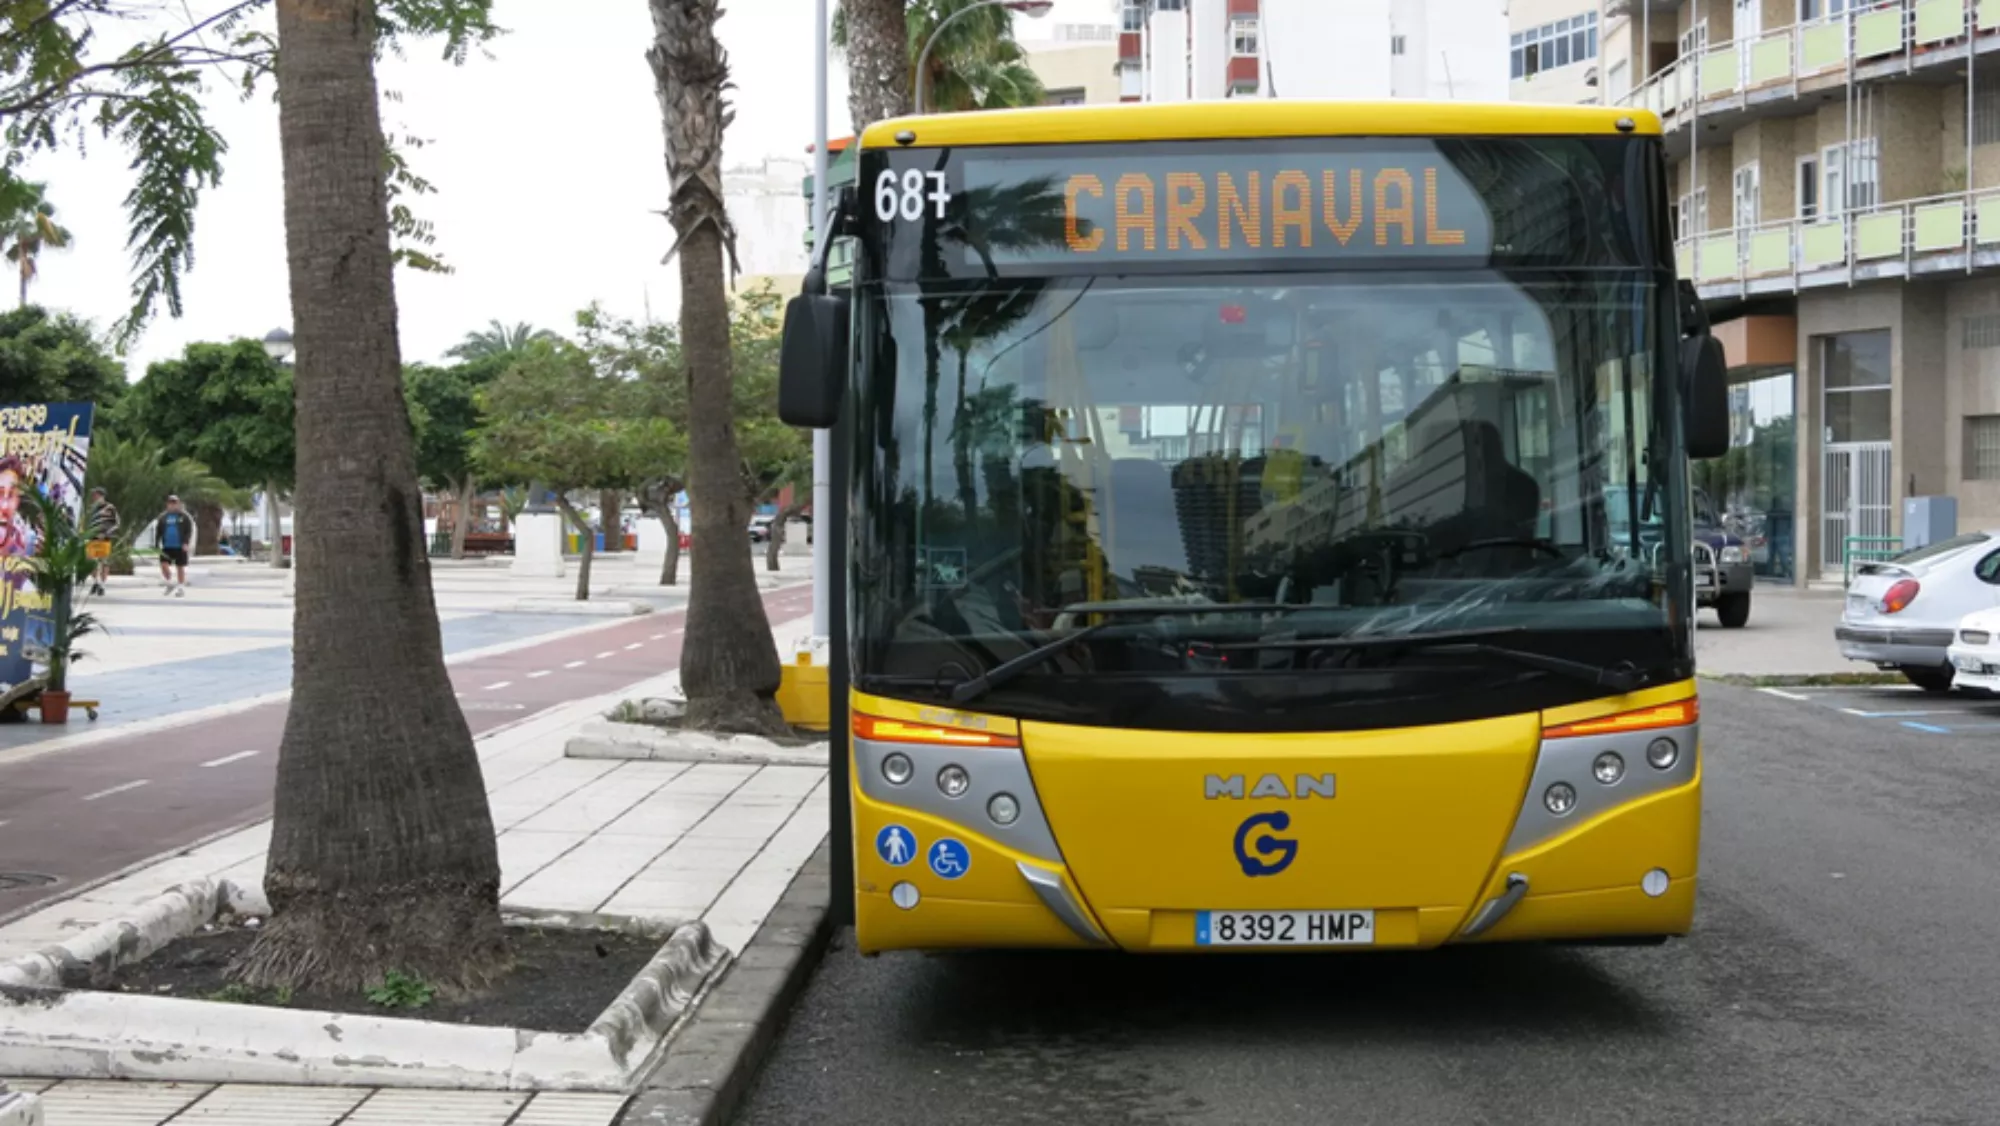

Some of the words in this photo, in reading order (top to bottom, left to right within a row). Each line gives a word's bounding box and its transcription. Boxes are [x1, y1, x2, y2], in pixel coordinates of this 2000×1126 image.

[875, 168, 951, 222] 687
[1065, 167, 1466, 252] CARNAVAL
[1204, 773, 1336, 799] MAN
[1219, 914, 1296, 940] 8392
[1308, 913, 1366, 940] HMP
